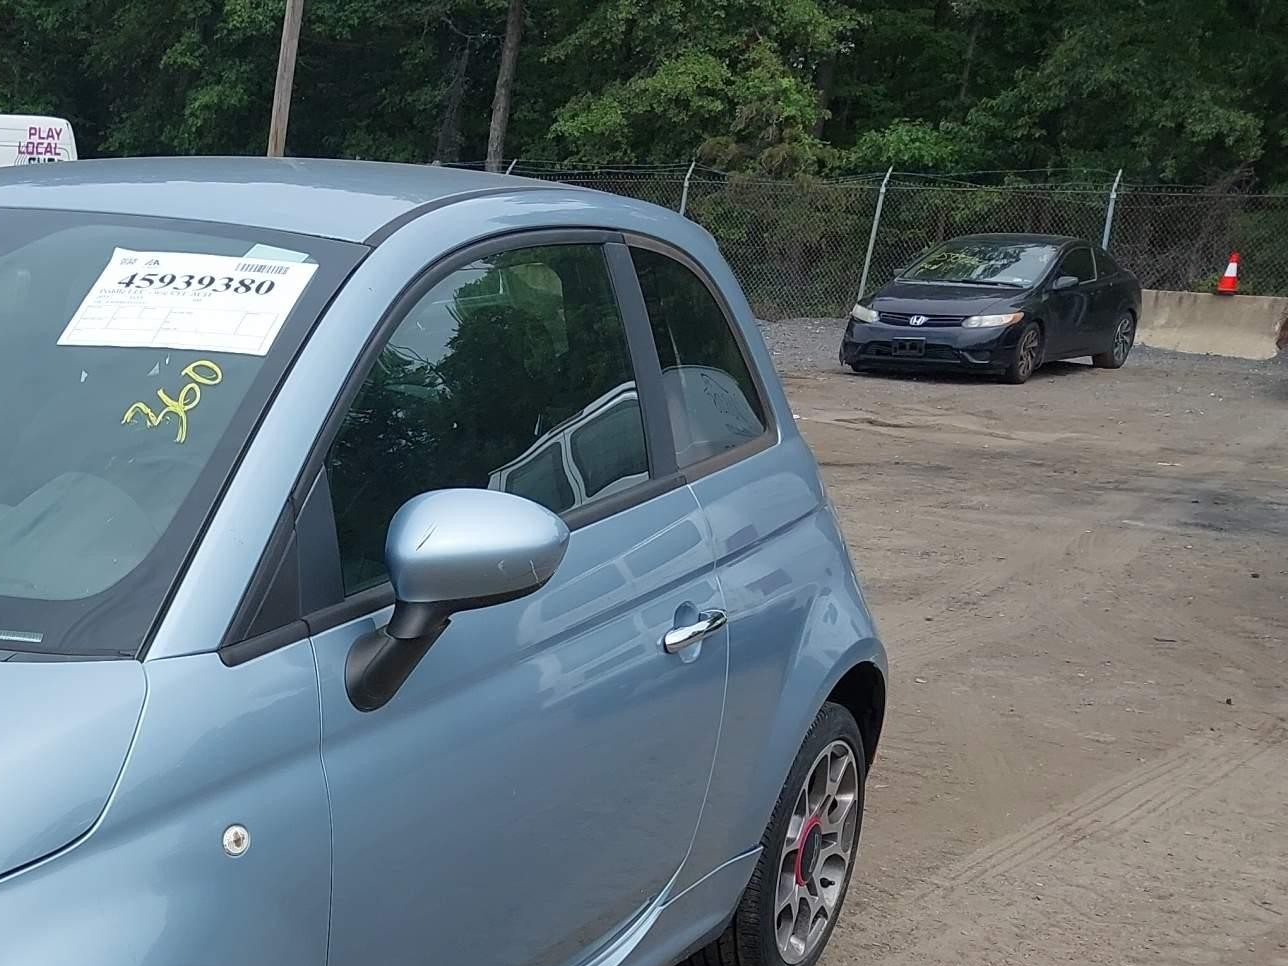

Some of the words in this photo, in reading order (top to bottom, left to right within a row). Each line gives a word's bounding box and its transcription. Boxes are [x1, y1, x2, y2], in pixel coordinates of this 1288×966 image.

[28, 126, 63, 141] PLAY
[17, 141, 62, 156] LOCAL
[116, 272, 276, 296] 45939380
